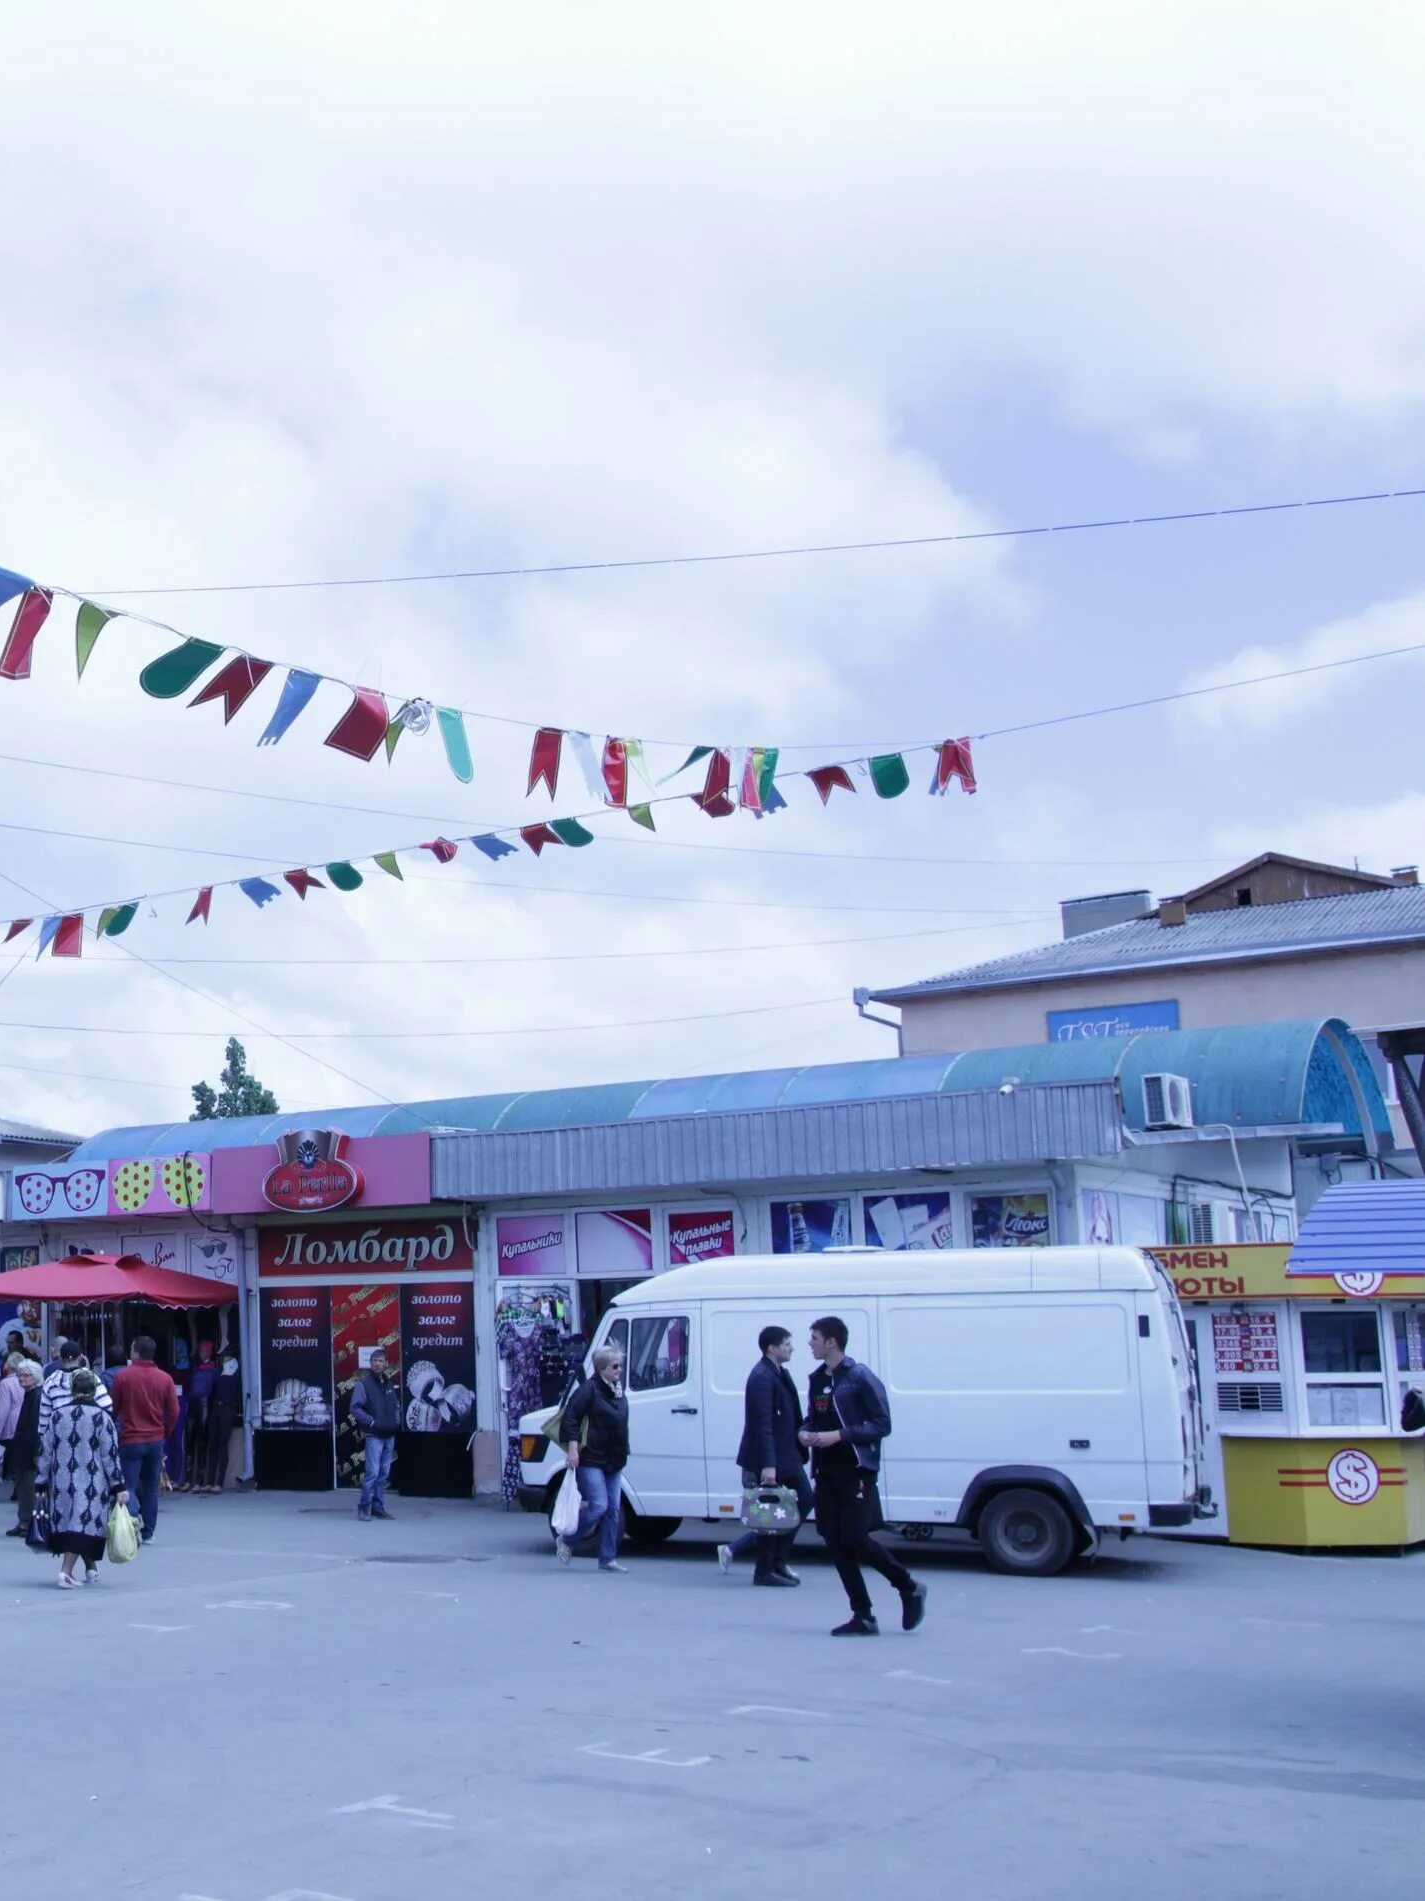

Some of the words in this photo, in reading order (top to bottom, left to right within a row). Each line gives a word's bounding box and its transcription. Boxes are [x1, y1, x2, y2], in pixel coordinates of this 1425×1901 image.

[672, 1219, 732, 1245] Купальные
[274, 1224, 455, 1271] Ломбард
[502, 1230, 562, 1259] Купальники
[684, 1237, 722, 1255] плавки
[1153, 1250, 1229, 1269] БМЕН
[1173, 1276, 1245, 1295] ЮТЫ
[271, 1297, 318, 1308] золото
[411, 1294, 462, 1305] золото
[278, 1317, 312, 1327] залог
[418, 1315, 456, 1325] залог
[272, 1335, 318, 1349] кредит
[412, 1333, 464, 1348] кредит
